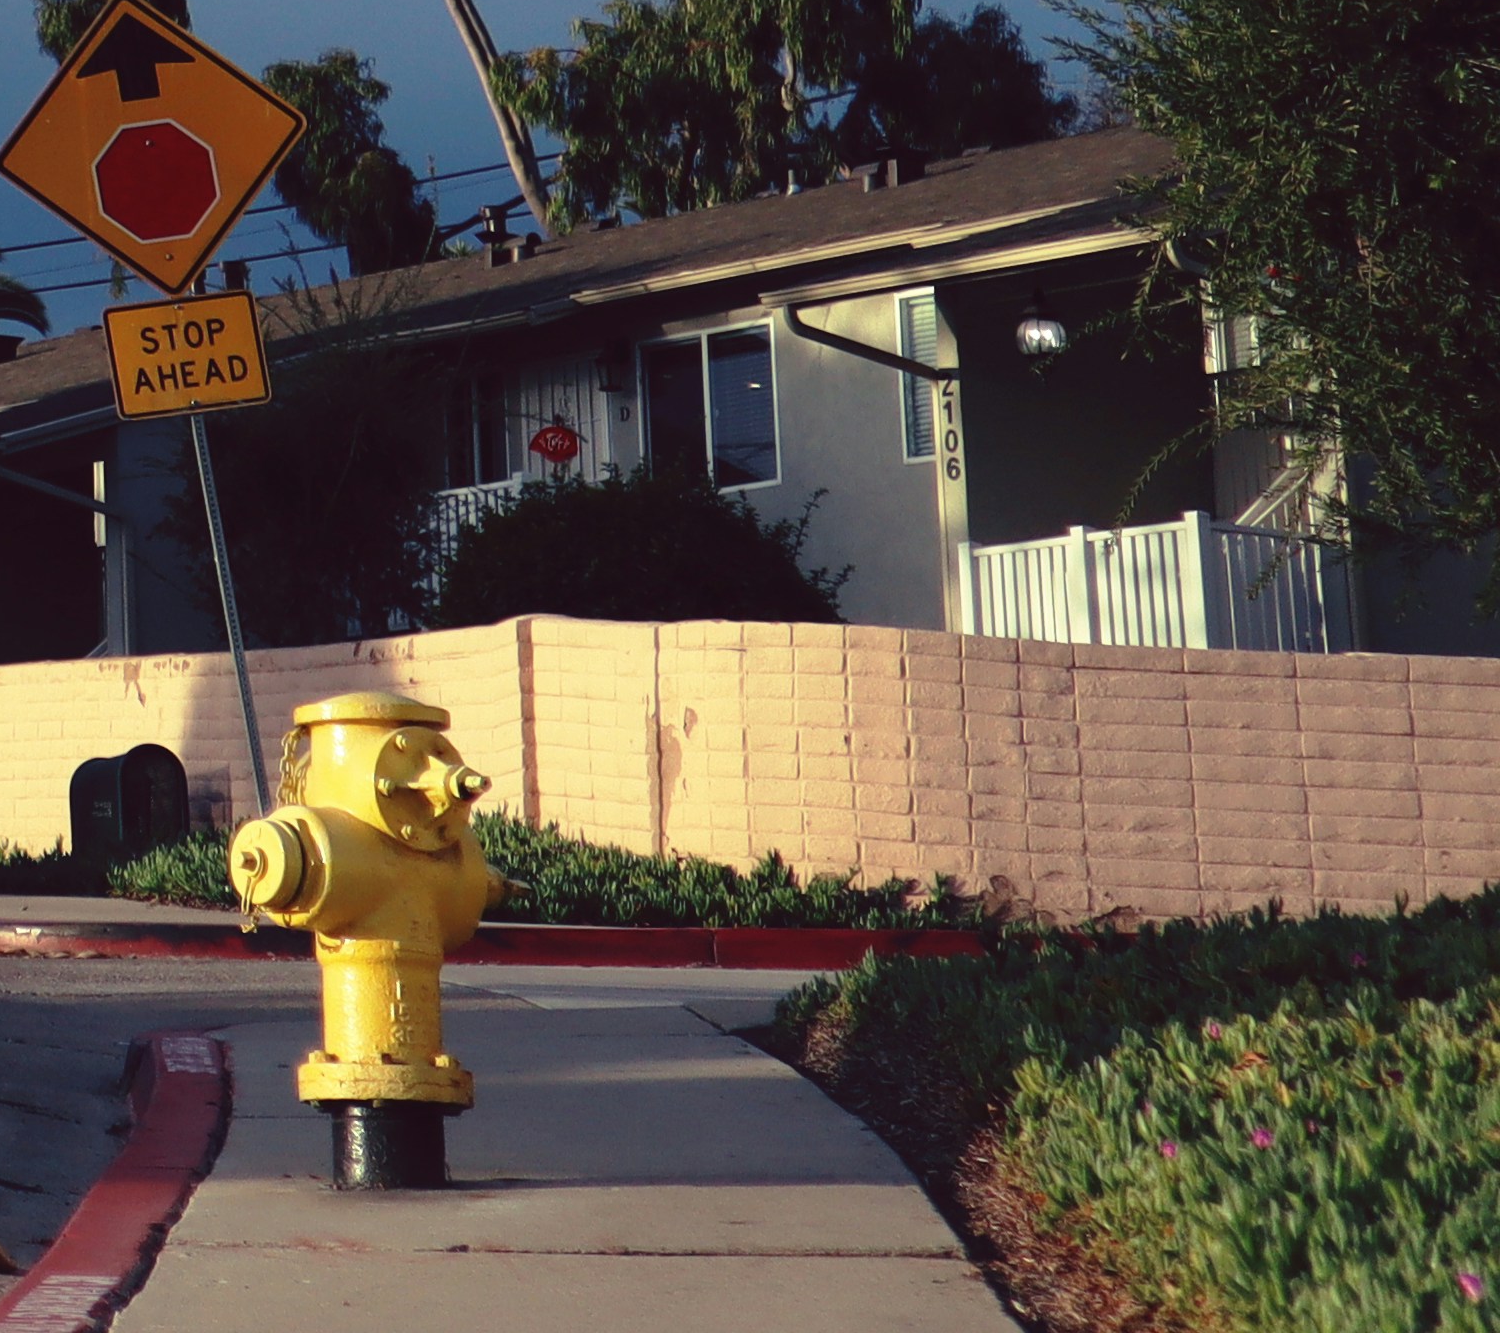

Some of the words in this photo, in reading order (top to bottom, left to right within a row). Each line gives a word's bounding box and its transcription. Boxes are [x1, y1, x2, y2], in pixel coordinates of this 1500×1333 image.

[139, 317, 226, 355] STOP
[133, 354, 249, 396] AHEAD
[620, 406, 631, 422] D
[941, 377, 961, 481] 2106
